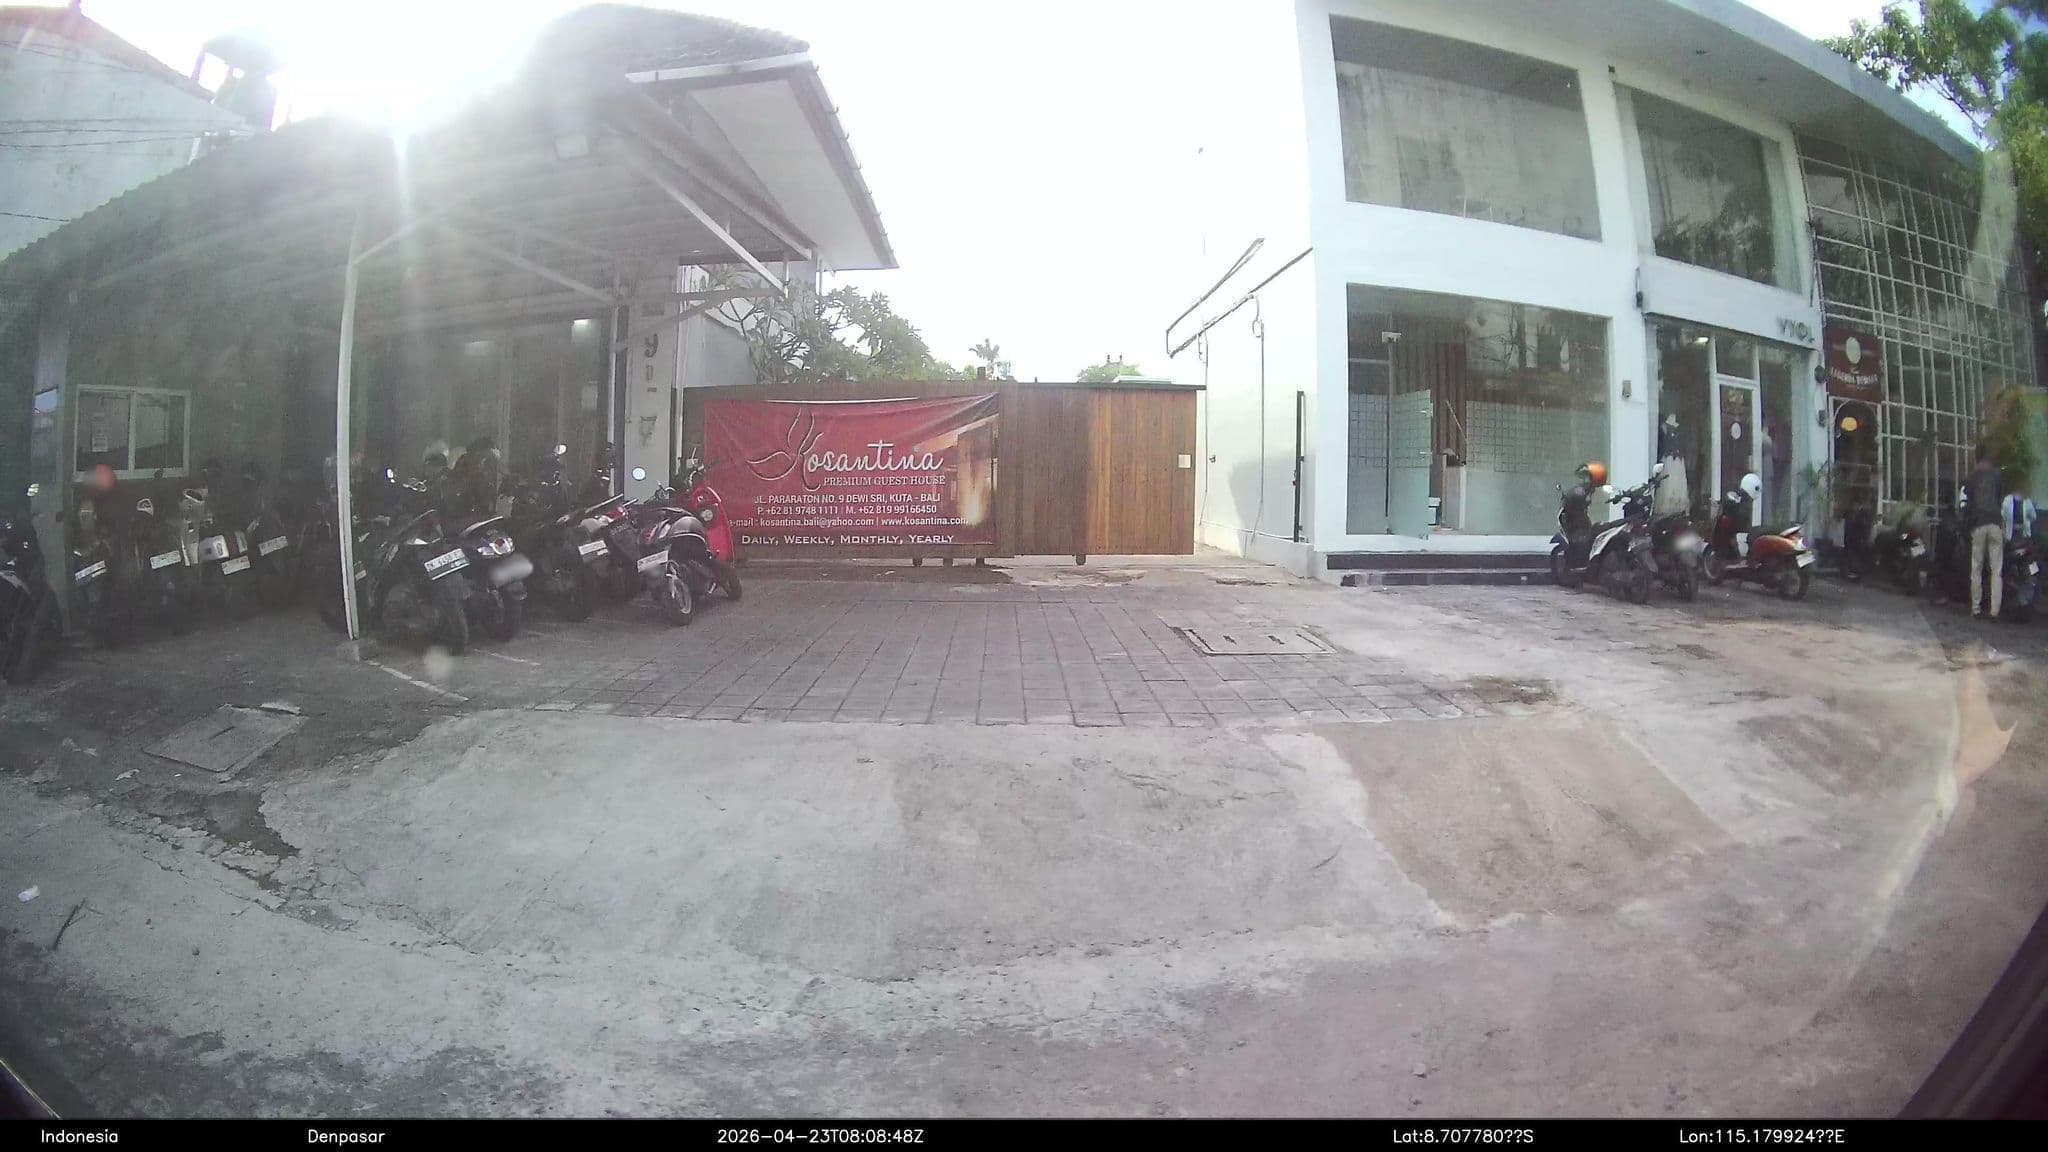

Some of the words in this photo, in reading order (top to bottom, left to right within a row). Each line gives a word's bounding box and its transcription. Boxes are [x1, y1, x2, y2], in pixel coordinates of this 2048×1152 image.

[747, 408, 944, 491] Kosantina
[823, 477, 872, 486] PREMIUM
[873, 476, 909, 485] GUEST
[910, 475, 946, 485] HOUSE
[768, 494, 820, 504] PARARATON
[838, 494, 844, 503] 9
[846, 493, 869, 503] DEWI
[870, 493, 888, 504] SRI,
[889, 493, 913, 502] KUTA
[920, 493, 941, 502] BALI
[766, 506, 781, 515] +62
[795, 506, 817, 515] 9748
[858, 505, 874, 514] +62
[876, 505, 892, 514] 819
[894, 505, 937, 514] 99166450
[760, 517, 874, 529] kosantina.bali@yahoo.com
[881, 516, 969, 526] www.kosantina.com
[908, 534, 955, 544] YEARLY
